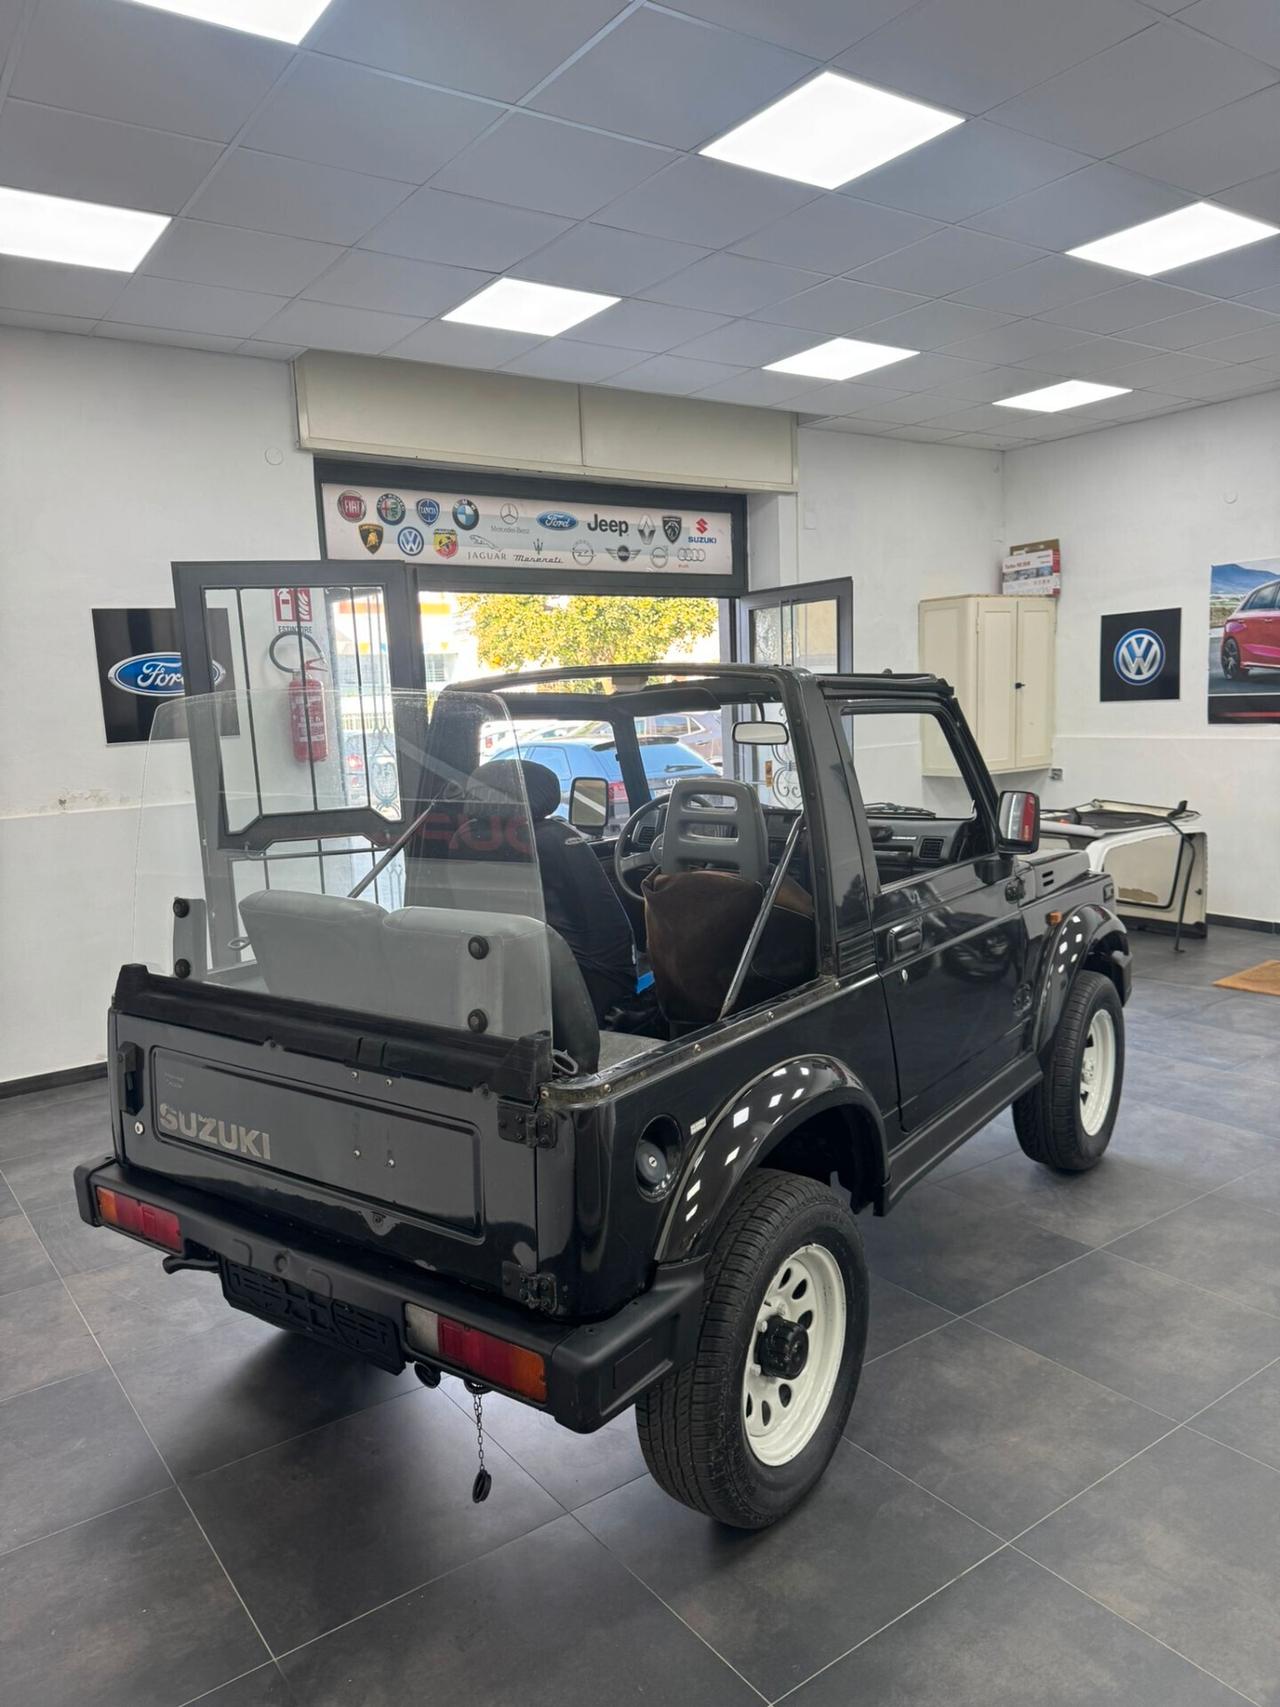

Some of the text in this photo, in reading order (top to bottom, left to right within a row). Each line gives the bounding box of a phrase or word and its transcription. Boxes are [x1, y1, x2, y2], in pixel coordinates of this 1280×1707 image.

[544, 513, 570, 528] Ford
[587, 513, 629, 537] Jeep
[688, 536, 717, 544] SUZUKI
[467, 551, 507, 560] JAGUAR
[513, 554, 564, 564] Maserati
[278, 625, 313, 634] ESTINORE
[137, 661, 185, 687] For
[159, 1103, 271, 1160] SUZUKI
